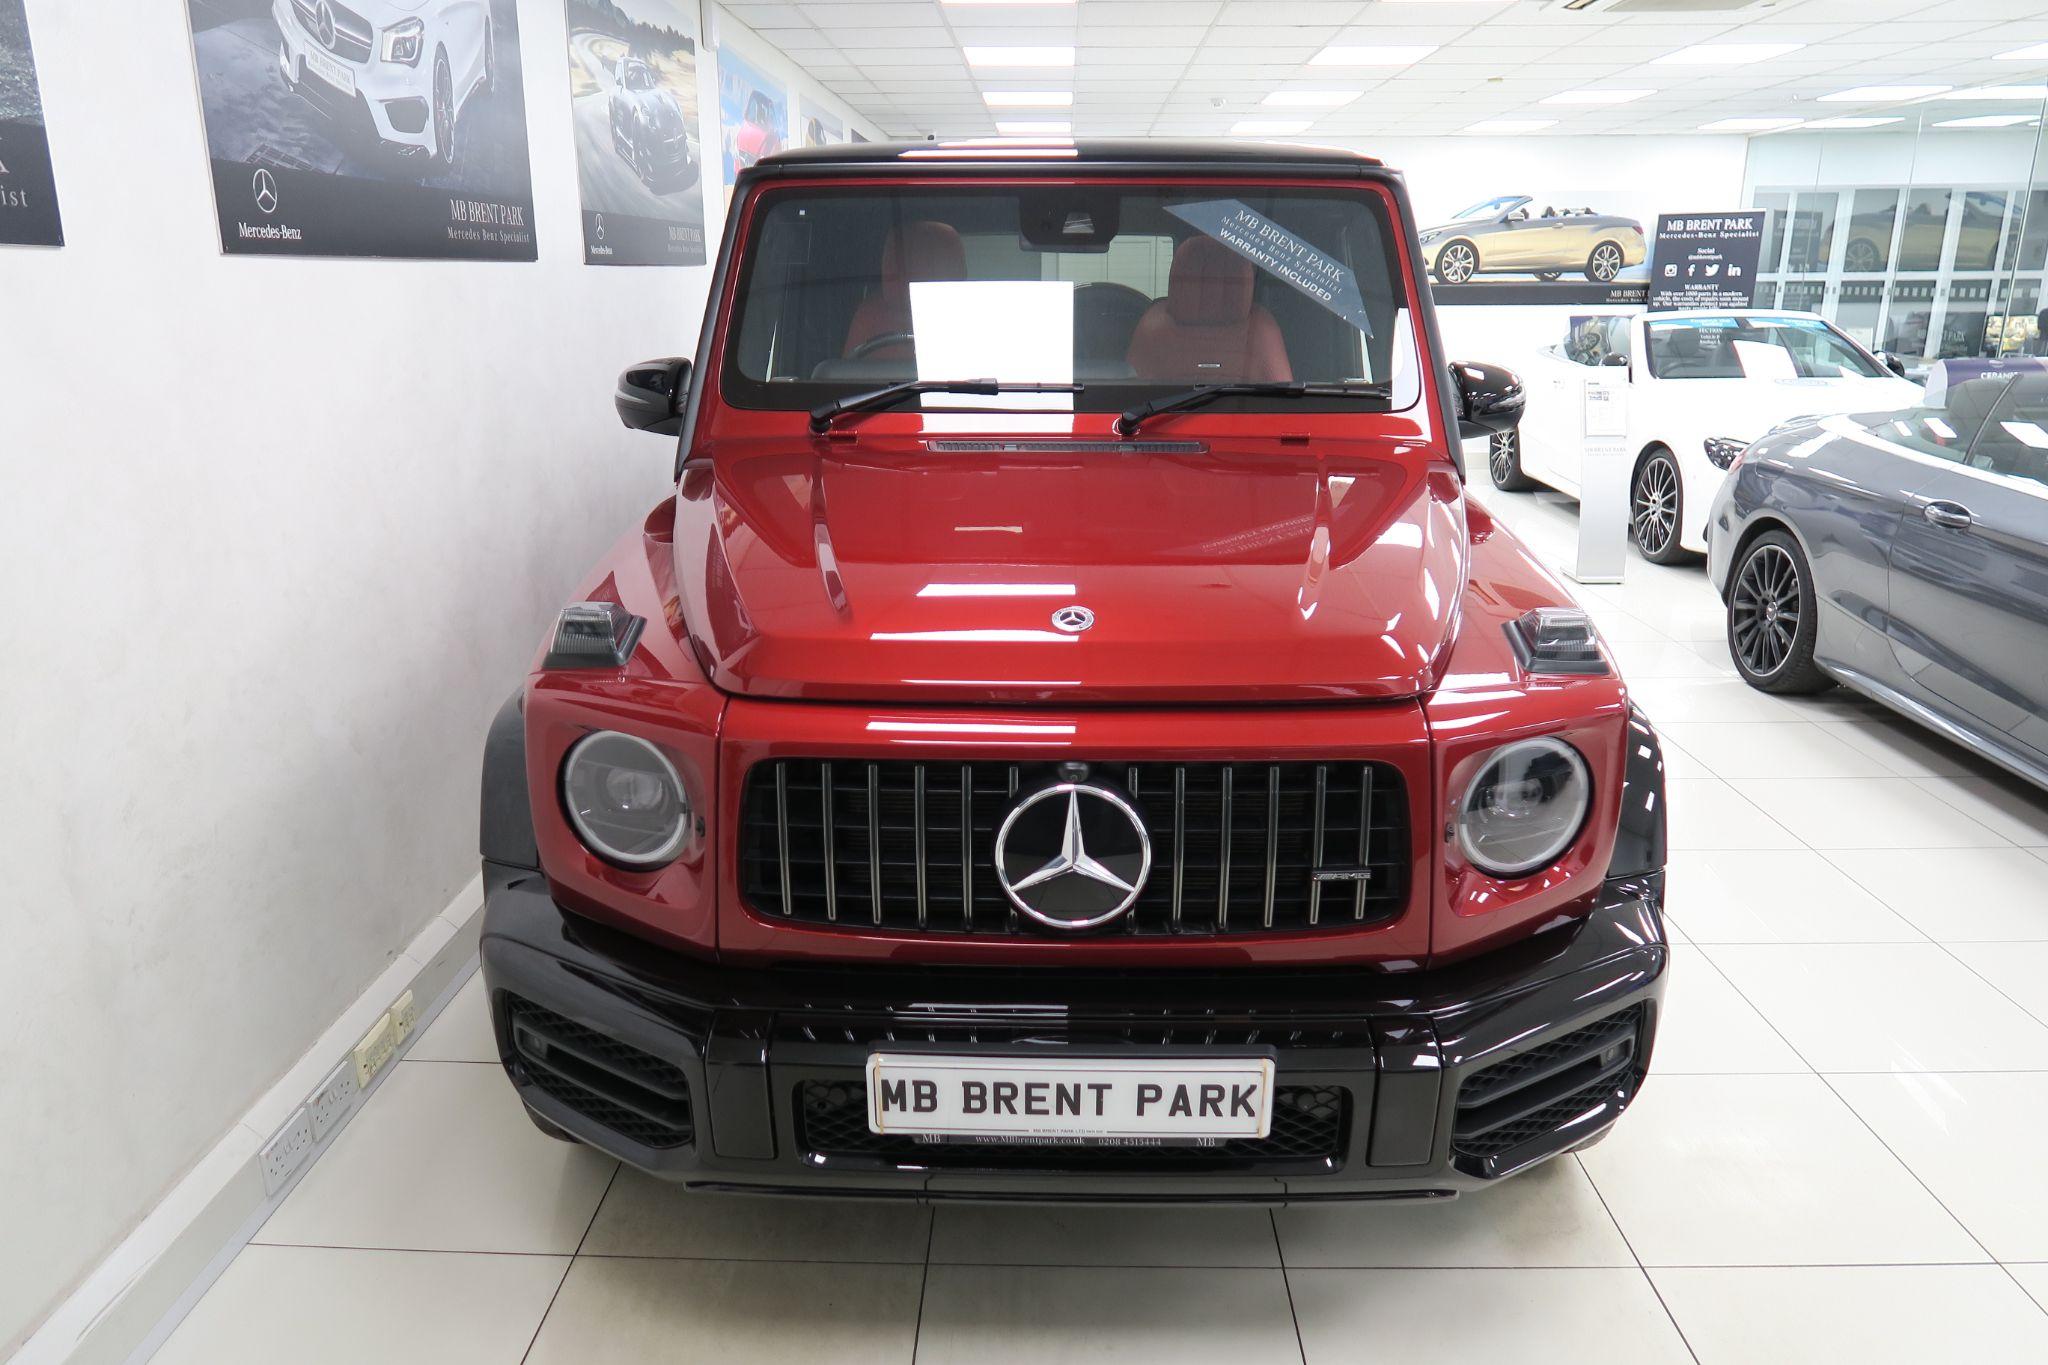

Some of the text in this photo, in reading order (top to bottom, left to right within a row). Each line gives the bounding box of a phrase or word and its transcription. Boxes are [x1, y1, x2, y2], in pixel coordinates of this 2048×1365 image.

[450, 199, 525, 226] MB BRENT PARK
[238, 222, 302, 239] Mercedes-Benz
[1667, 218, 1753, 231] MB BRENT PARK
[447, 226, 530, 244] Mercedes Benz Specialist
[1719, 231, 1760, 239] Specialist
[1234, 209, 1345, 283] MB BRENT PARK
[1221, 216, 1265, 247] Mercedes
[1294, 260, 1343, 294] Specialist
[1219, 228, 1332, 301] WARRANTY INCLUDED
[1623, 289, 1646, 297] BRENT
[1980, 371, 2019, 380] CERAMI
[880, 1079, 1258, 1117] MB BRENT PARK
[922, 1134, 941, 1143] MB
[1196, 1138, 1216, 1147] MB
